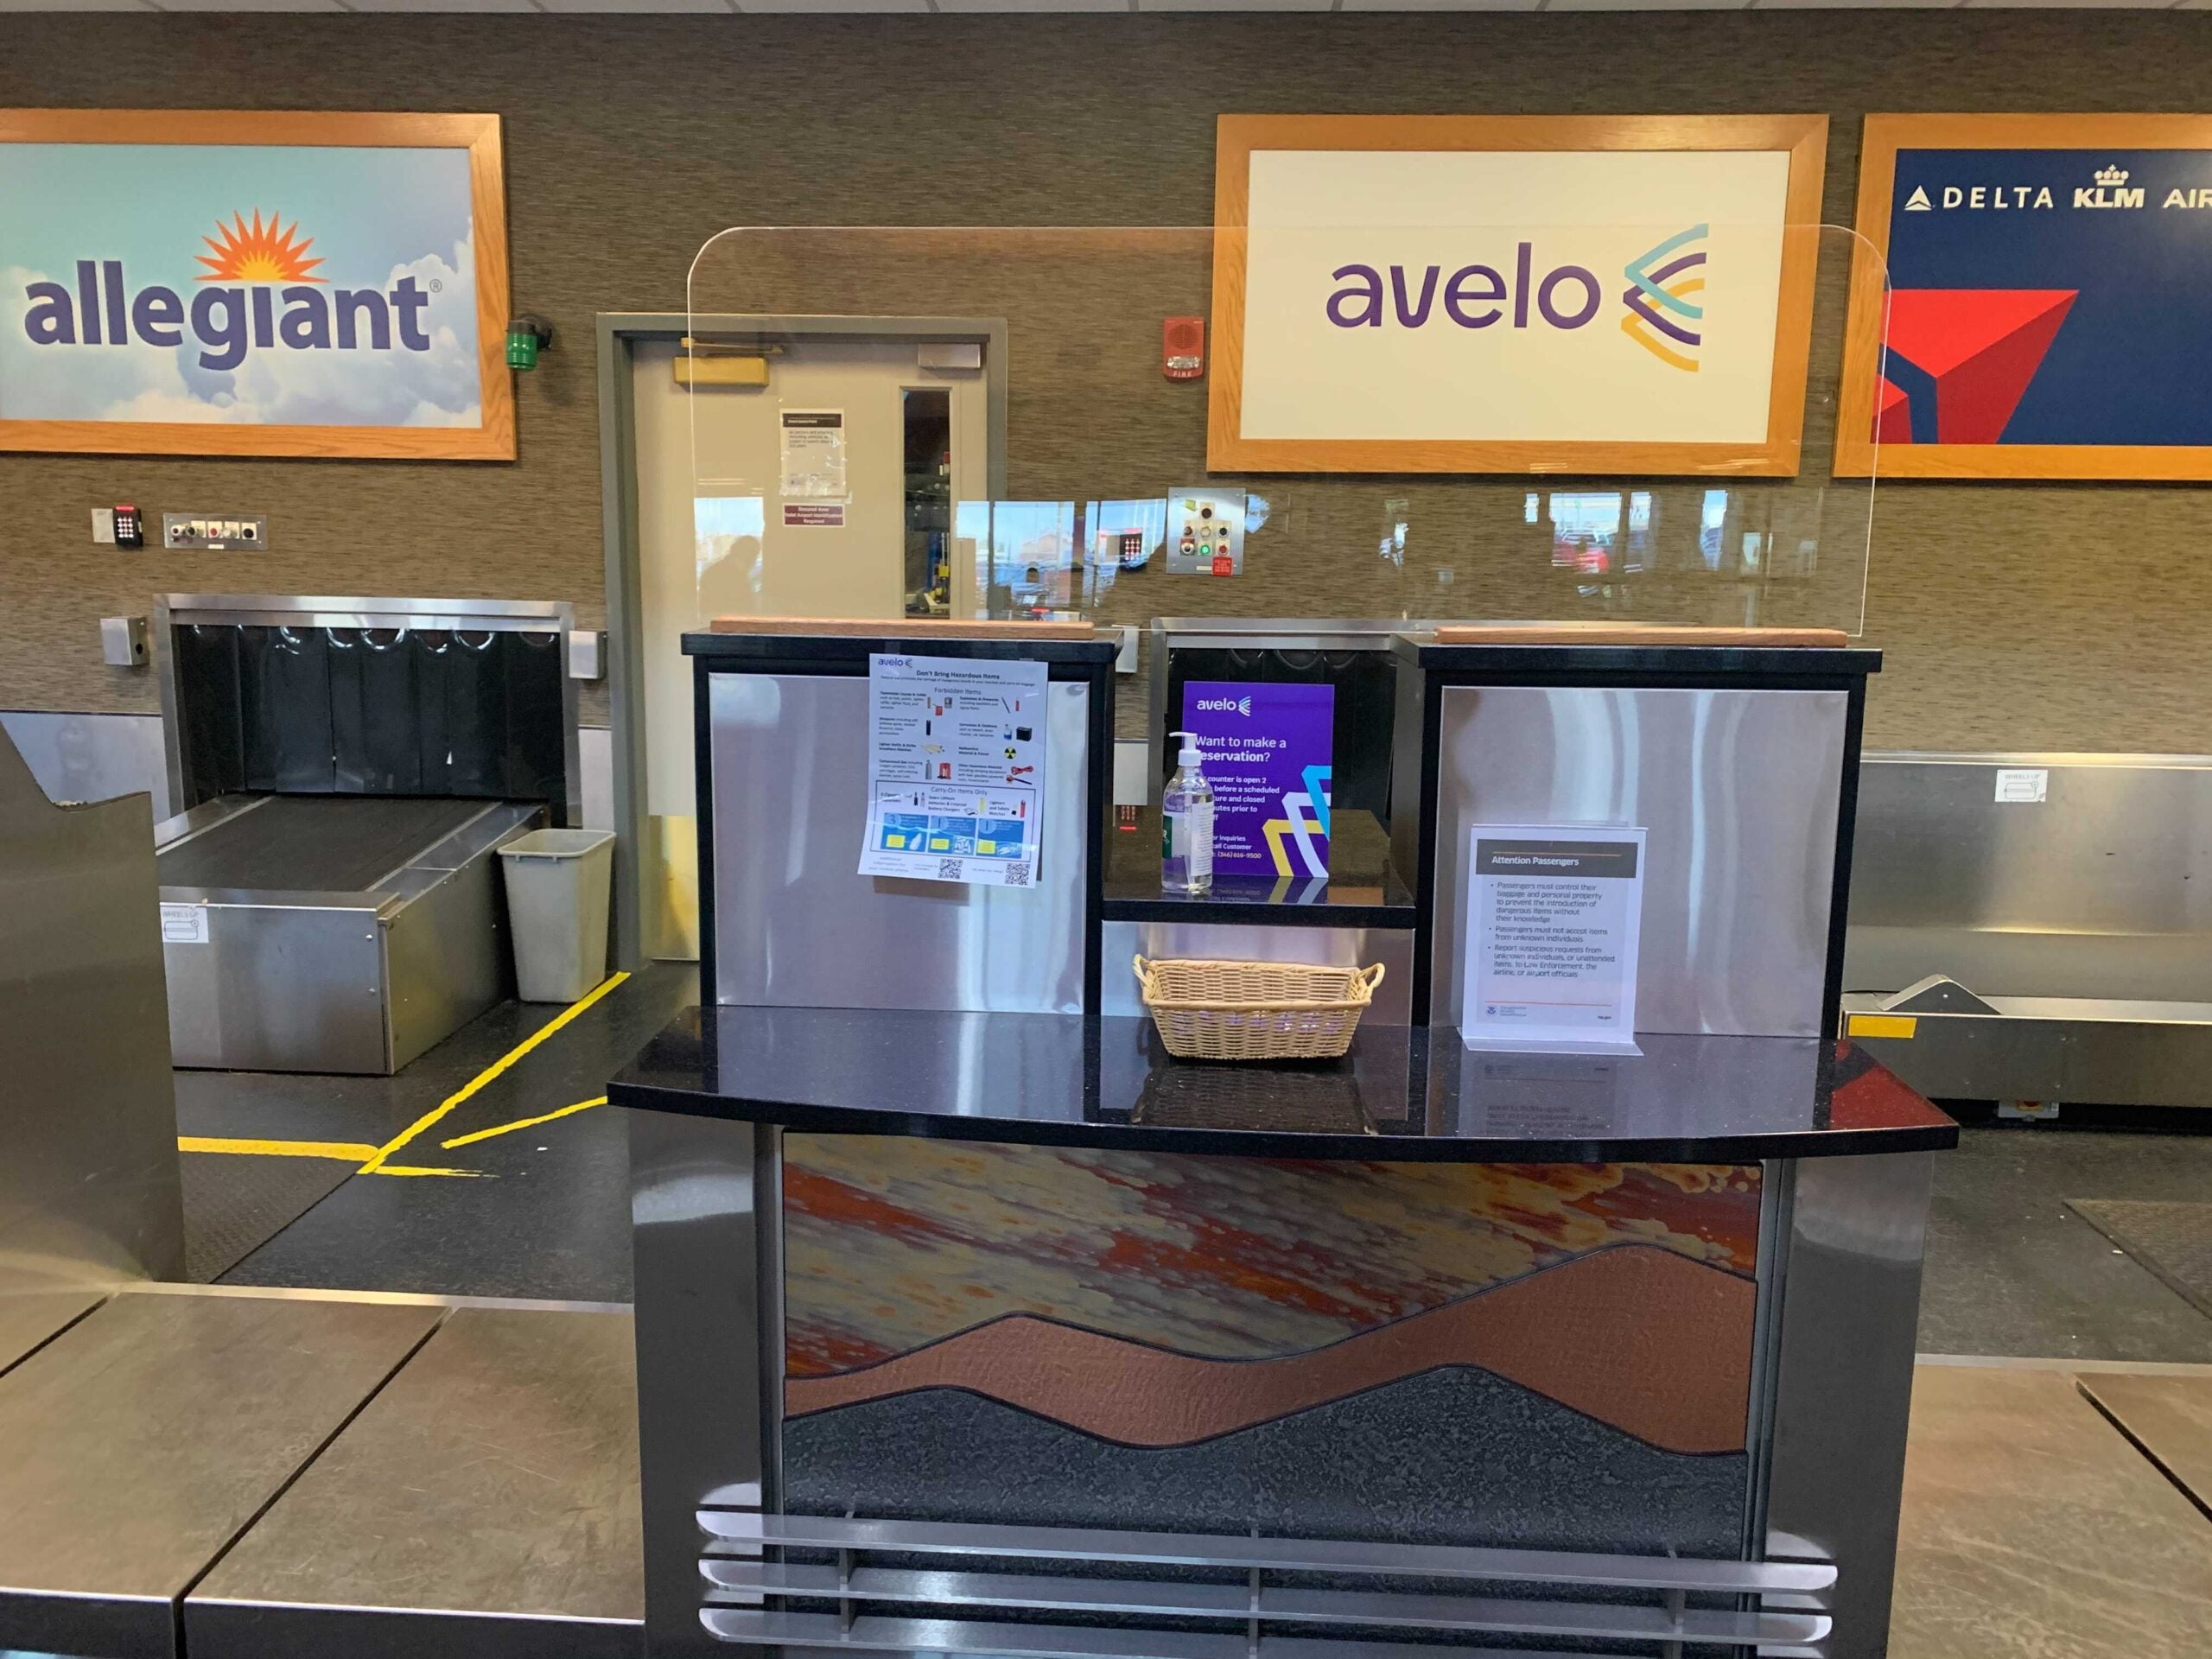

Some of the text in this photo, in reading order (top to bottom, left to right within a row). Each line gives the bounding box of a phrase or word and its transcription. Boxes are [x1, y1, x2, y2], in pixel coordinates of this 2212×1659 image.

[1943, 187, 2054, 208] DELTA
[2073, 188, 2145, 208] KLM
[1325, 242, 1601, 329] avelo
[24, 260, 430, 371] allegiant
[878, 658, 904, 667] avelo
[934, 671, 950, 679] Bring
[1197, 697, 1236, 711] avelo
[1196, 735, 1287, 748] Want to make a
[1200, 750, 1271, 762] eservation?
[1491, 855, 1580, 867] Attention Passengers
[1497, 881, 1535, 891] Passengers
[1496, 906, 1531, 915] dangerous
[1513, 915, 1551, 924] knowledge
[1495, 925, 1533, 934] Passengers
[1494, 944, 1517, 952] Report
[1518, 944, 1553, 953] suspicious
[1554, 945, 1584, 954] requests
